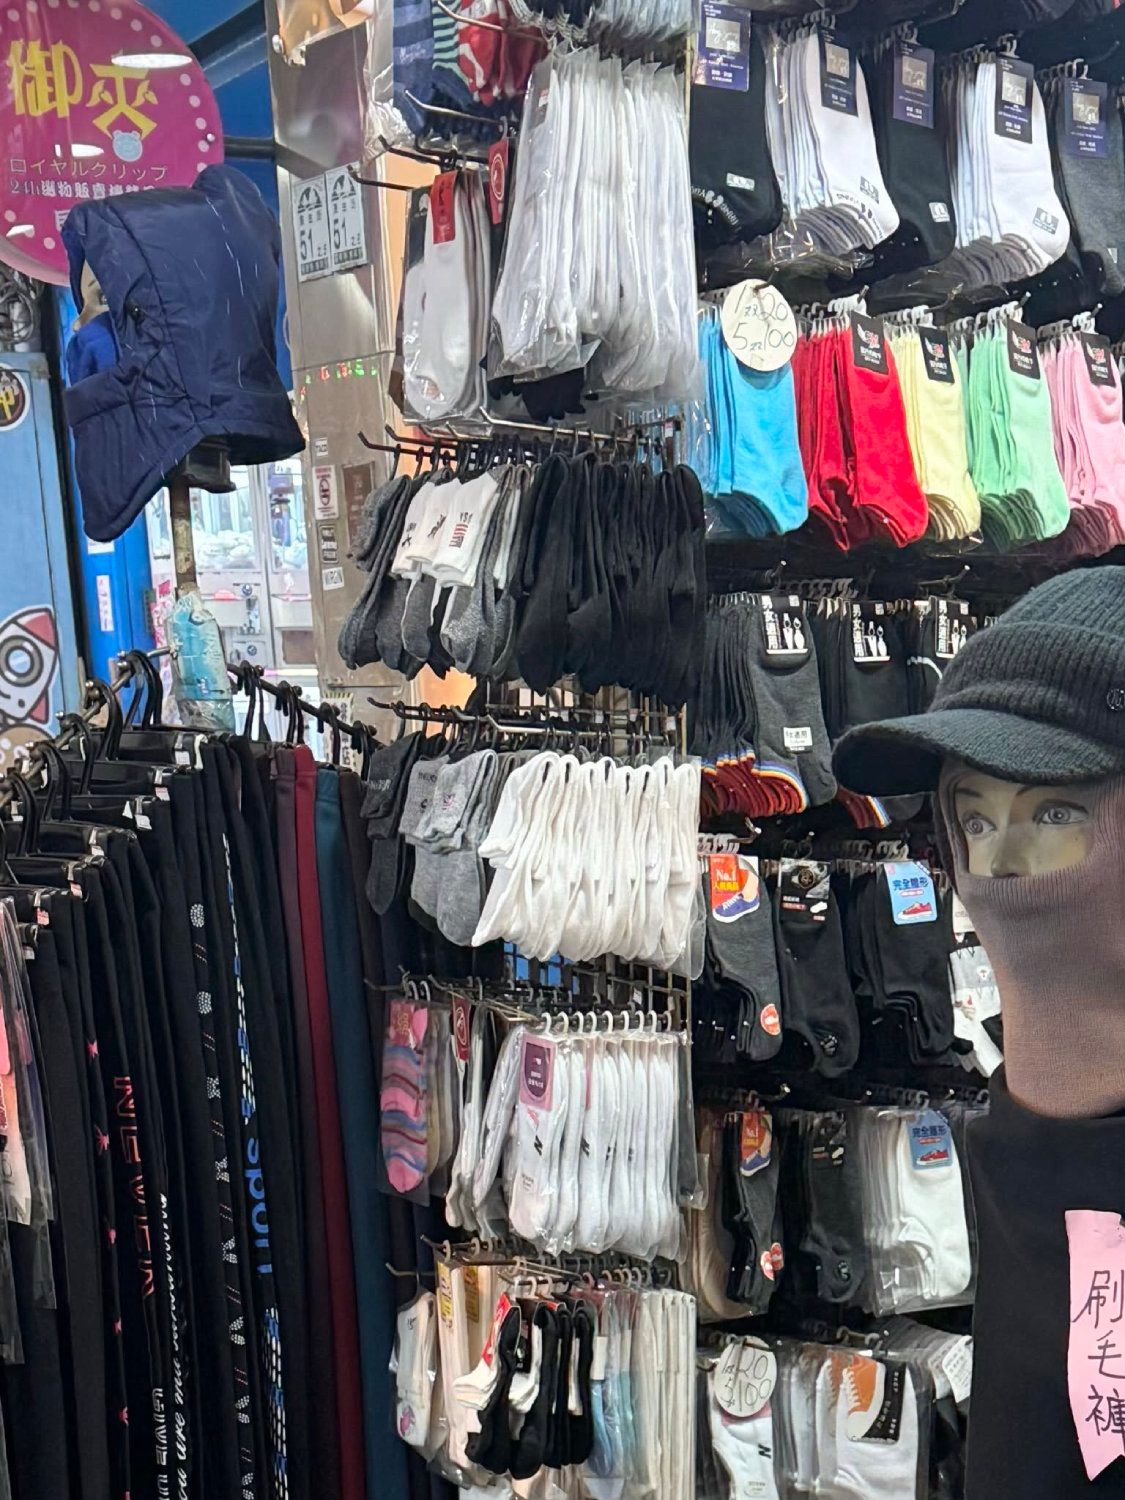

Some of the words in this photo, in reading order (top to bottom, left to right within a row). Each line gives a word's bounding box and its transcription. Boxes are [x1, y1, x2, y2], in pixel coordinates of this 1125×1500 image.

[10, 158, 168, 181] ロイヤルクリップ
